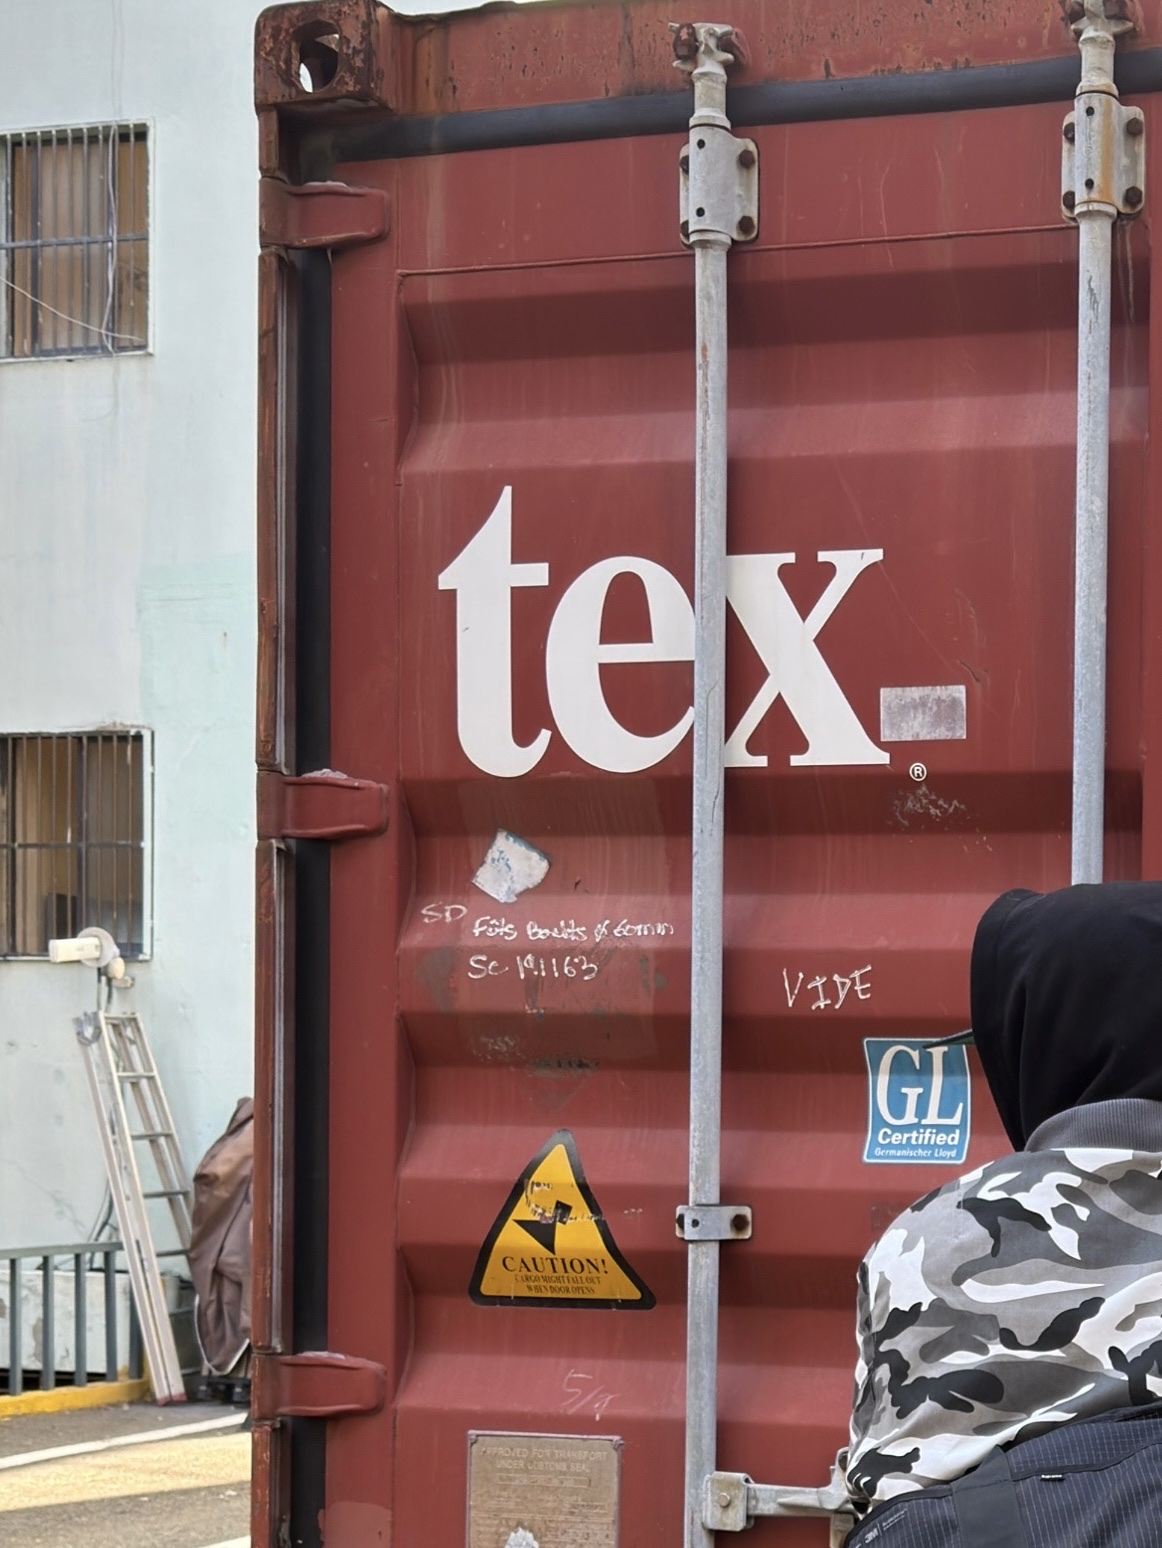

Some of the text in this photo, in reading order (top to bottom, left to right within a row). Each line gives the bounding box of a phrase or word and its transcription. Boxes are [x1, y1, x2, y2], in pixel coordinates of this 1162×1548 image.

[437, 485, 890, 778] tex
[782, 964, 873, 1011] VIDE
[876, 1044, 964, 1126] GL
[877, 1127, 960, 1146] Certified
[874, 1147, 957, 1159] Germanischer Lloyd
[502, 1256, 609, 1275] CAUTION!
[514, 1274, 540, 1283] CARGO
[549, 1285, 571, 1295] DOOR
[572, 1286, 595, 1295] OPENS
